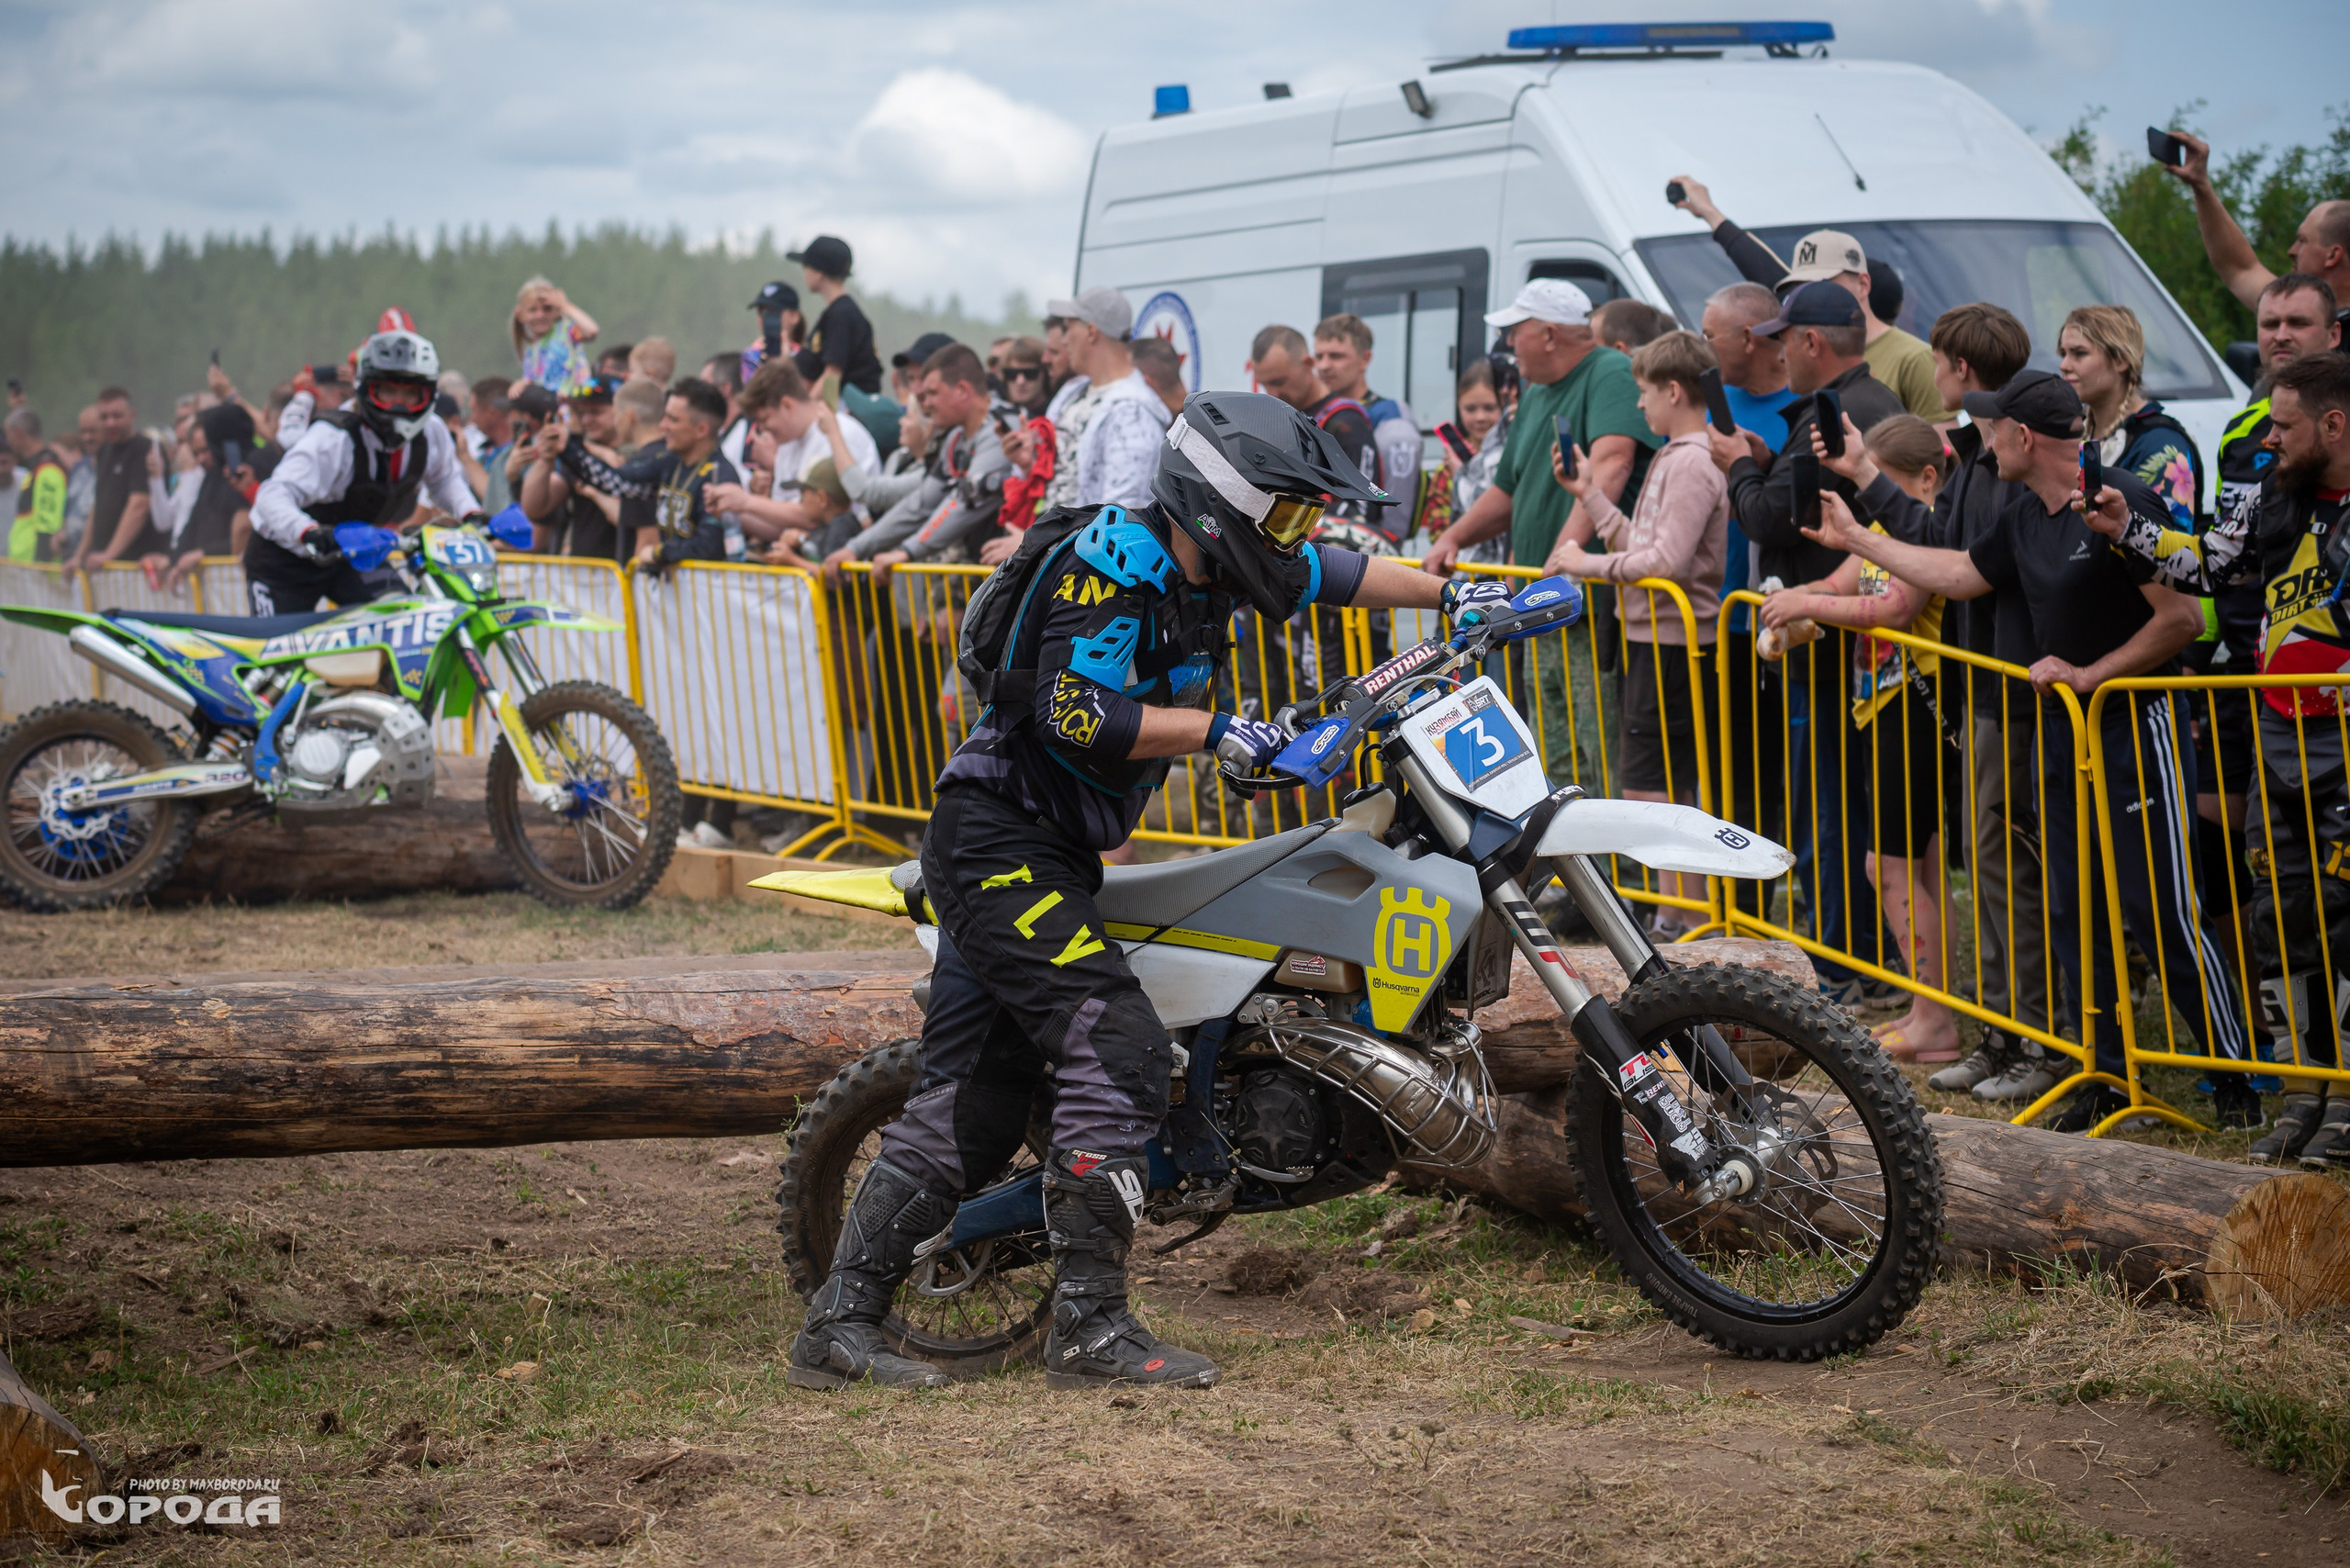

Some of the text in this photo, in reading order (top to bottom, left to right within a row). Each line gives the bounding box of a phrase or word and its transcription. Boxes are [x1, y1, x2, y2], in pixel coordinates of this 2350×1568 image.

[261, 611, 455, 660] AVANTIS
[1363, 644, 1438, 696] RENTHAL
[1926, 699, 1948, 727] LVE
[1459, 716, 1505, 767] 3
[1382, 980, 1420, 993] Husqvarna
[1645, 1272, 1673, 1300] ENDURO
[1671, 1294, 1698, 1318] TUAPSE
